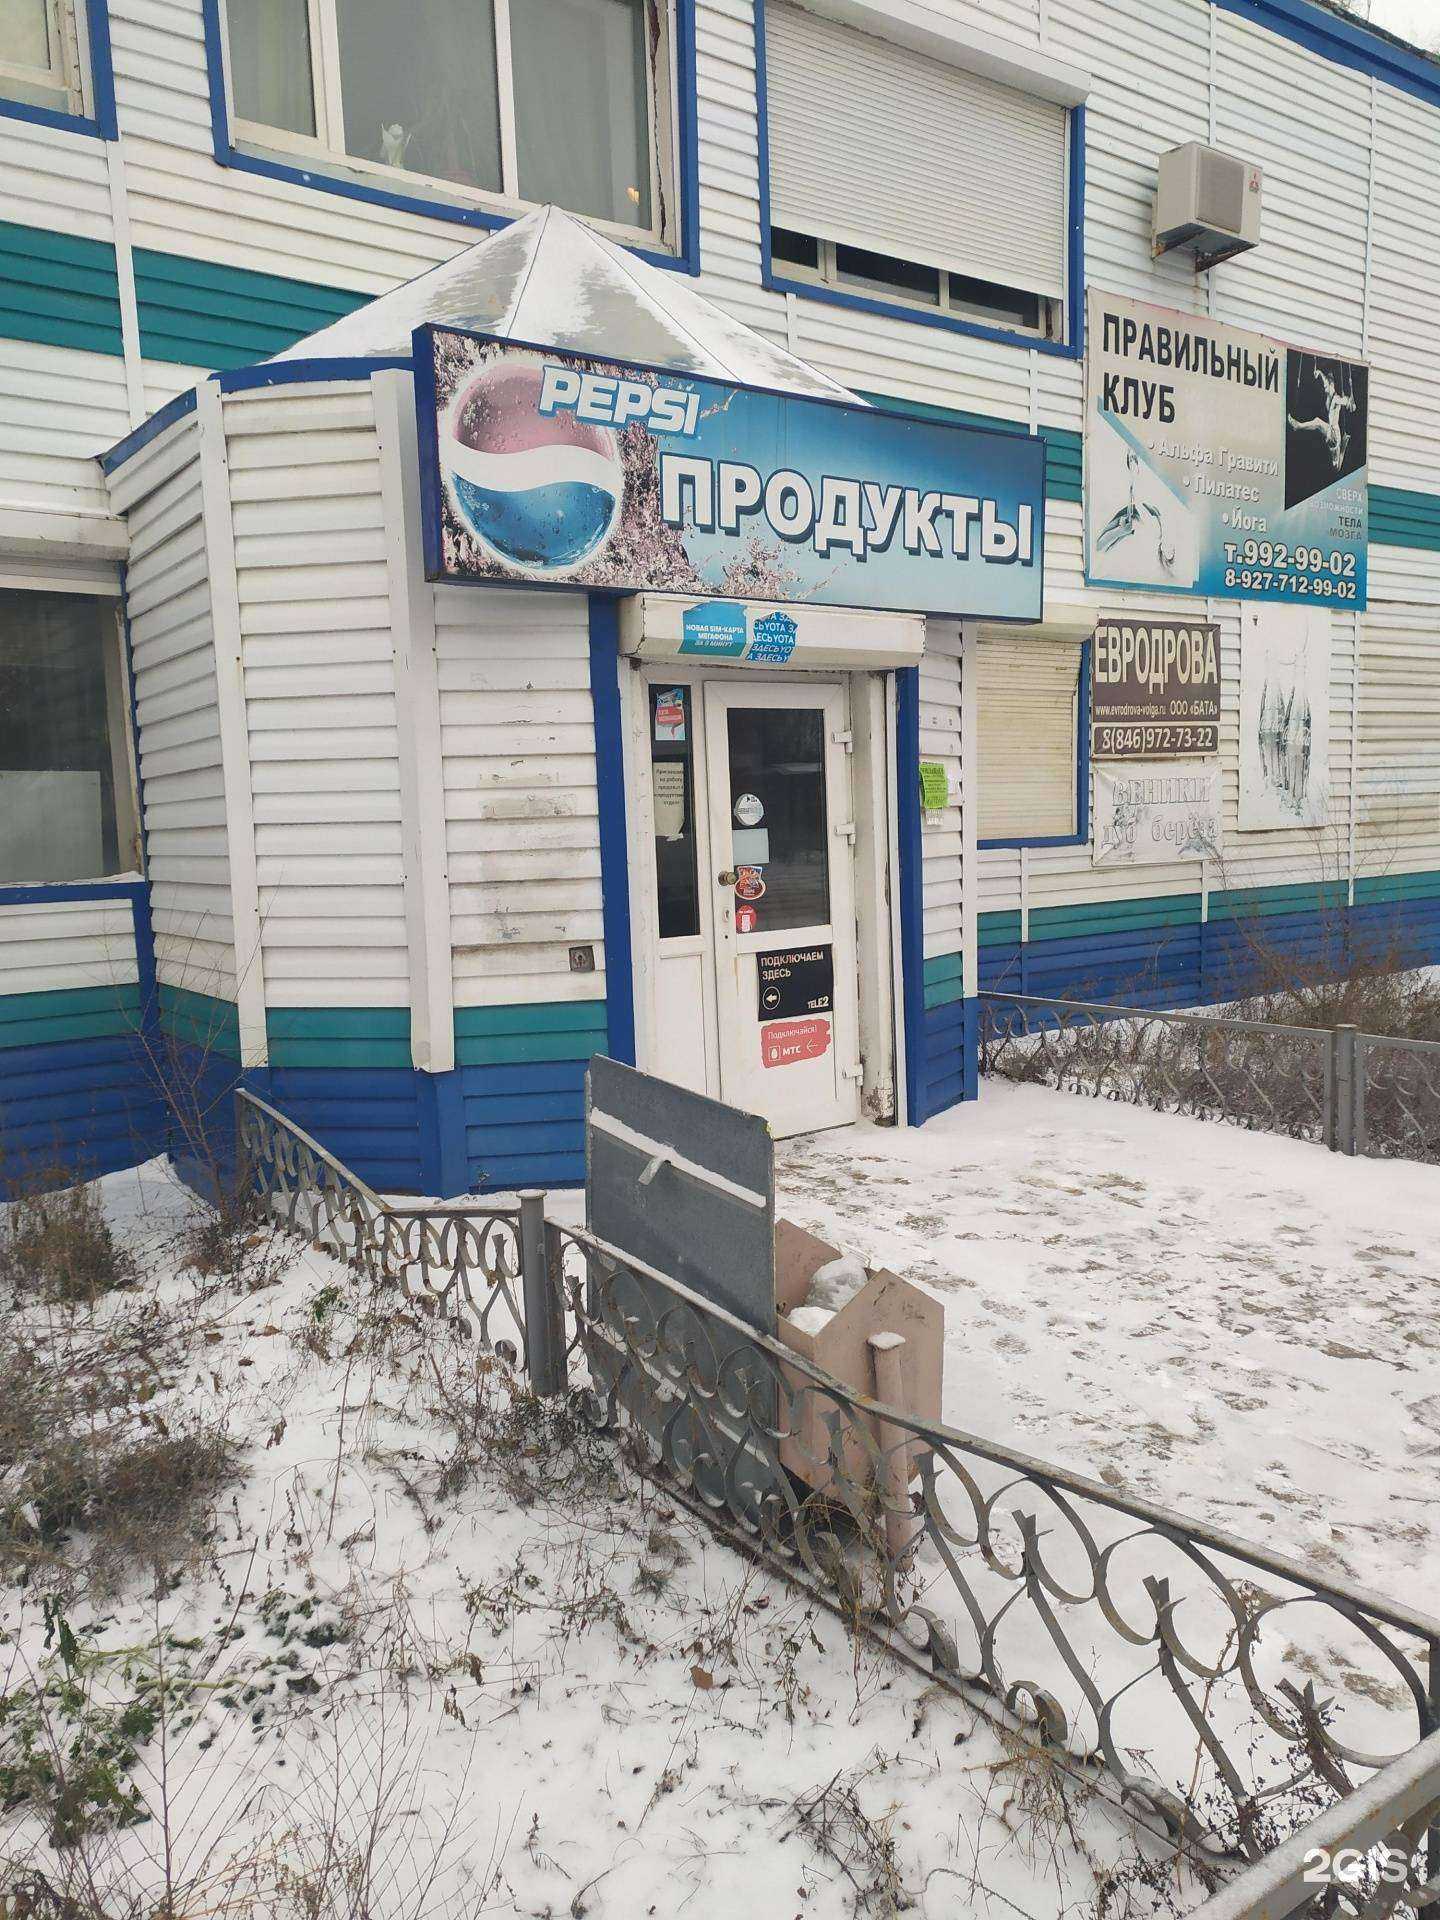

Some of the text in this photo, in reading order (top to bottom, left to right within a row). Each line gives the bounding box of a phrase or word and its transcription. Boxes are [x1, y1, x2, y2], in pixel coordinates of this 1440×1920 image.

[1103, 312, 1279, 394] ПРАВИЛЬНЫЙ
[540, 366, 700, 438] PEPSI
[1103, 372, 1176, 424] КЛУБ
[1158, 440, 1280, 477] Альфа Гравити
[1193, 473, 1260, 502] Пилатес
[659, 449, 1035, 566] ПРОДУКТЫ
[1231, 505, 1267, 533] Йога
[1328, 527, 1363, 540] МОЗГА
[1338, 516, 1363, 528] ТЕЛА
[1223, 539, 1357, 577] т.992-99-02
[1224, 568, 1357, 600] 8-927-712-99-02
[1094, 626, 1218, 695] ЕВРОДРОВА
[1170, 700, 1188, 716] ООО
[1189, 700, 1218, 716] «БАТА»
[1102, 726, 1213, 754] 8(846)972-73-22
[760, 951, 824, 967] ПОДКЛЮЧАЕМ
[762, 968, 791, 980] ЗДЕСЬ
[807, 996, 829, 1009] TELE2
[768, 1025, 817, 1040] Подключайся!
[782, 1045, 802, 1056] МТС
